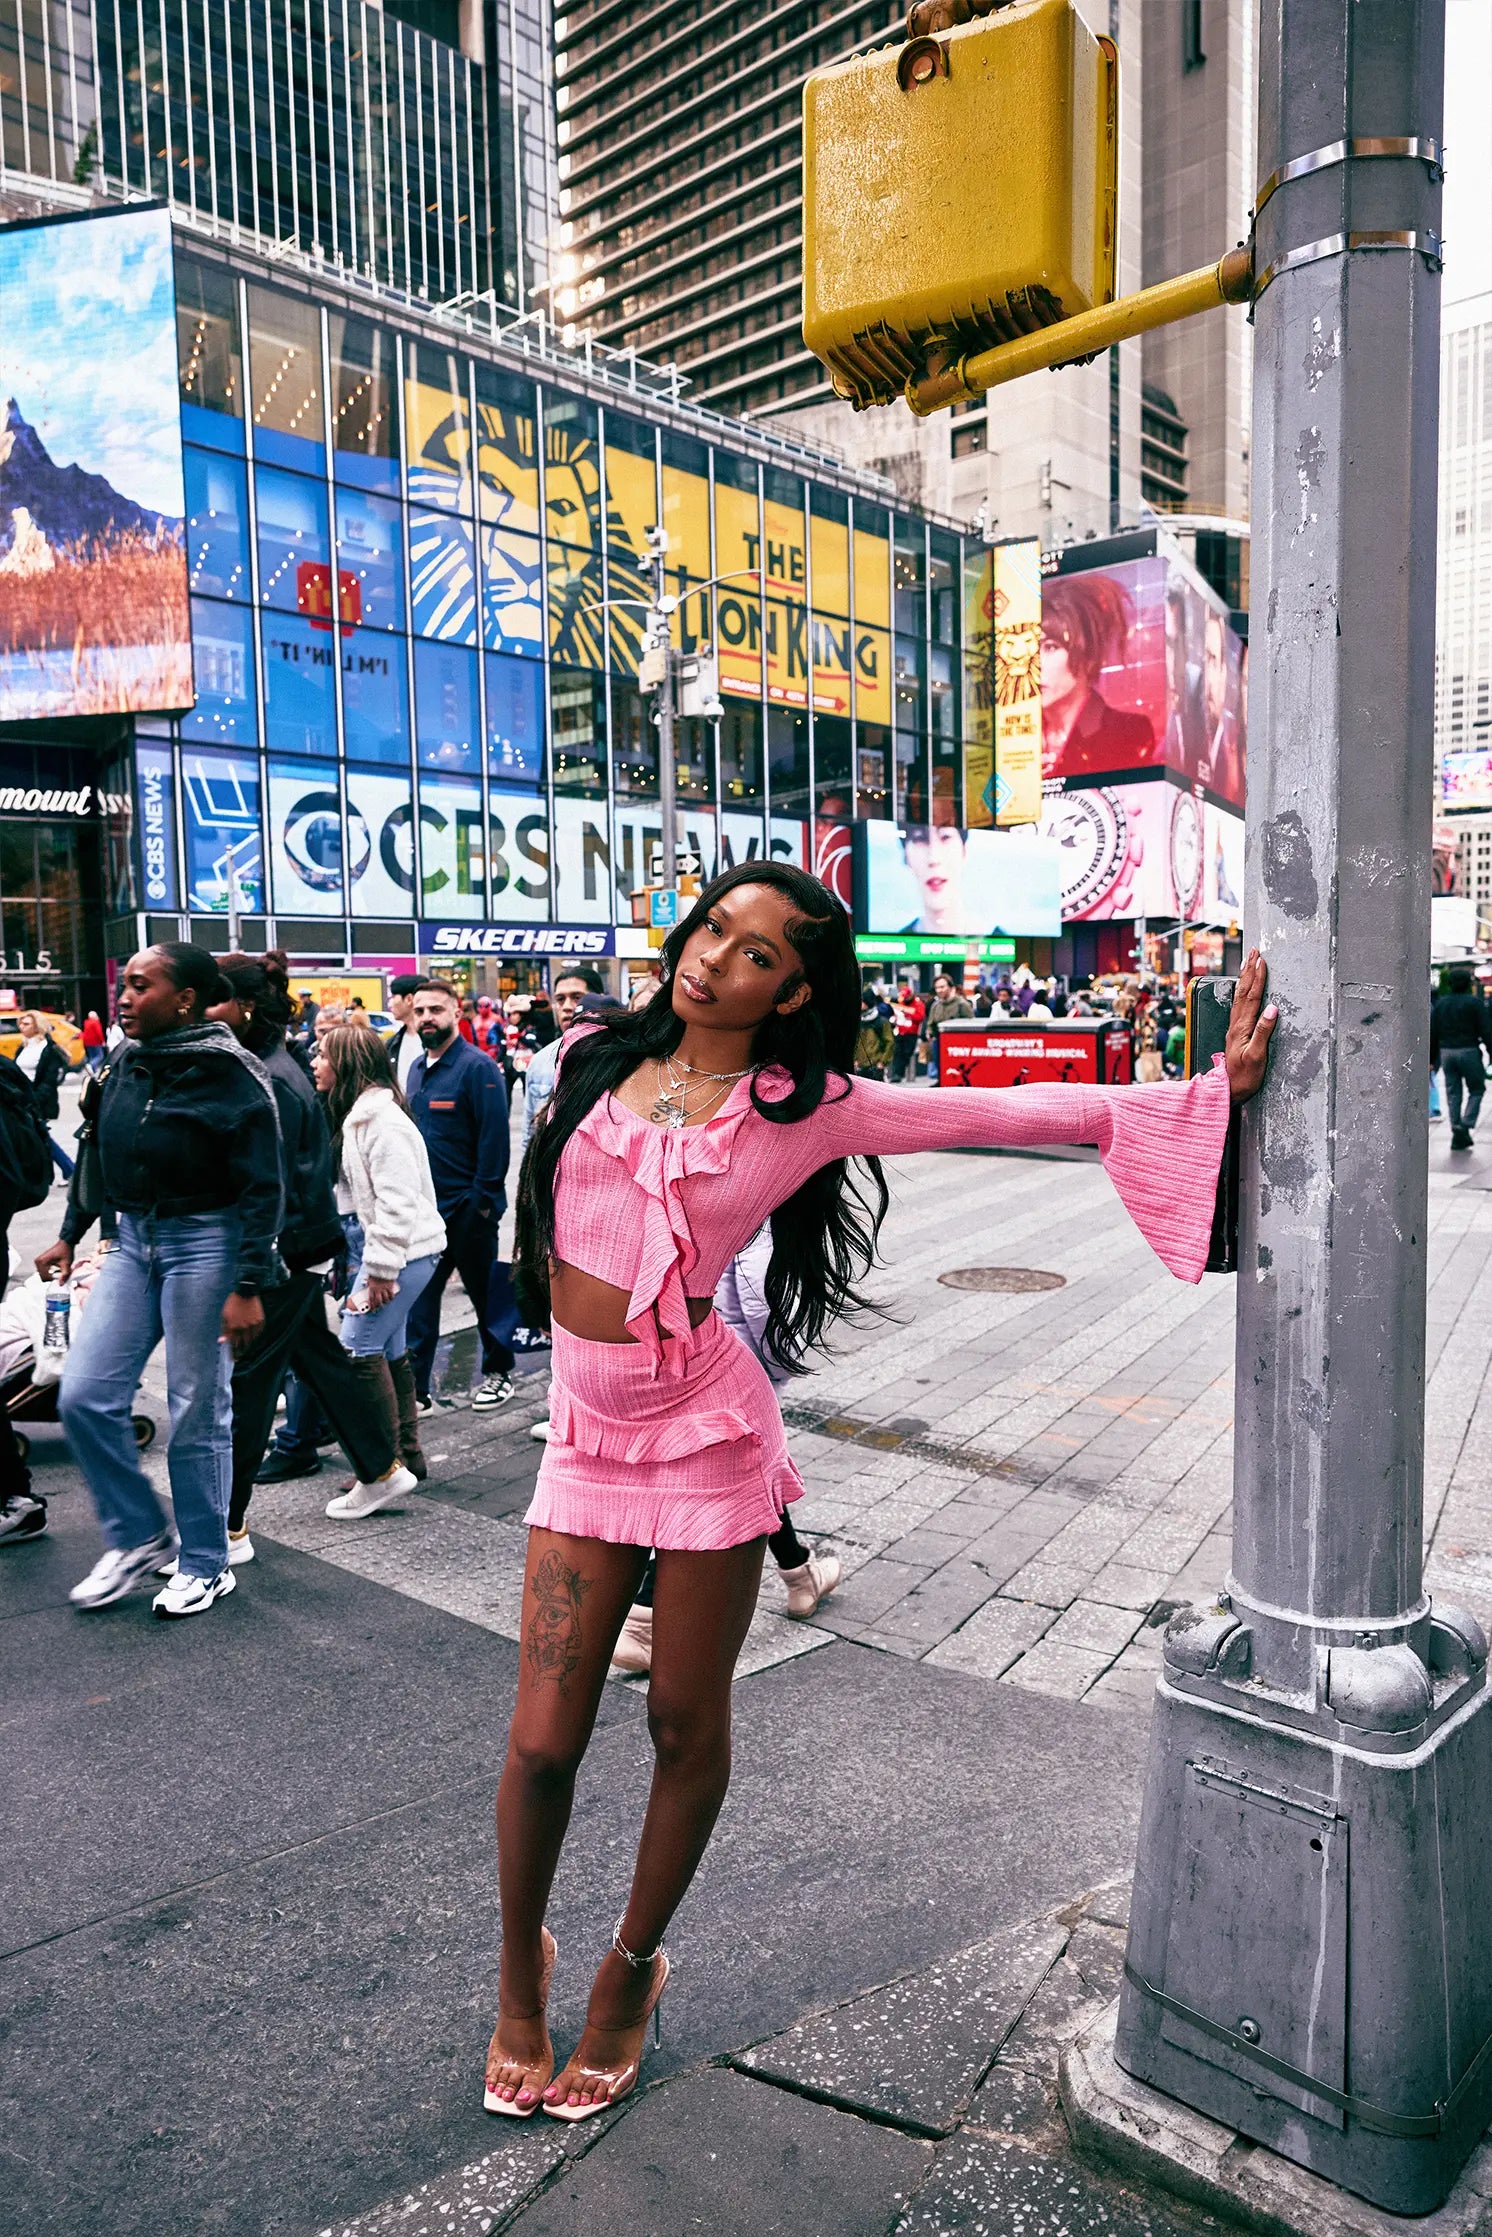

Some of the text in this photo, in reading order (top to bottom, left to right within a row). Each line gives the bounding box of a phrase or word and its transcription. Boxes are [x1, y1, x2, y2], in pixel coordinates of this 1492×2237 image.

[743, 532, 805, 583] THE
[678, 564, 878, 678] LION KING
[144, 766, 165, 880] CBS NEWS
[379, 802, 561, 899] CBS
[433, 927, 608, 953] SKECHERS
[947, 1046, 971, 1057] TONY
